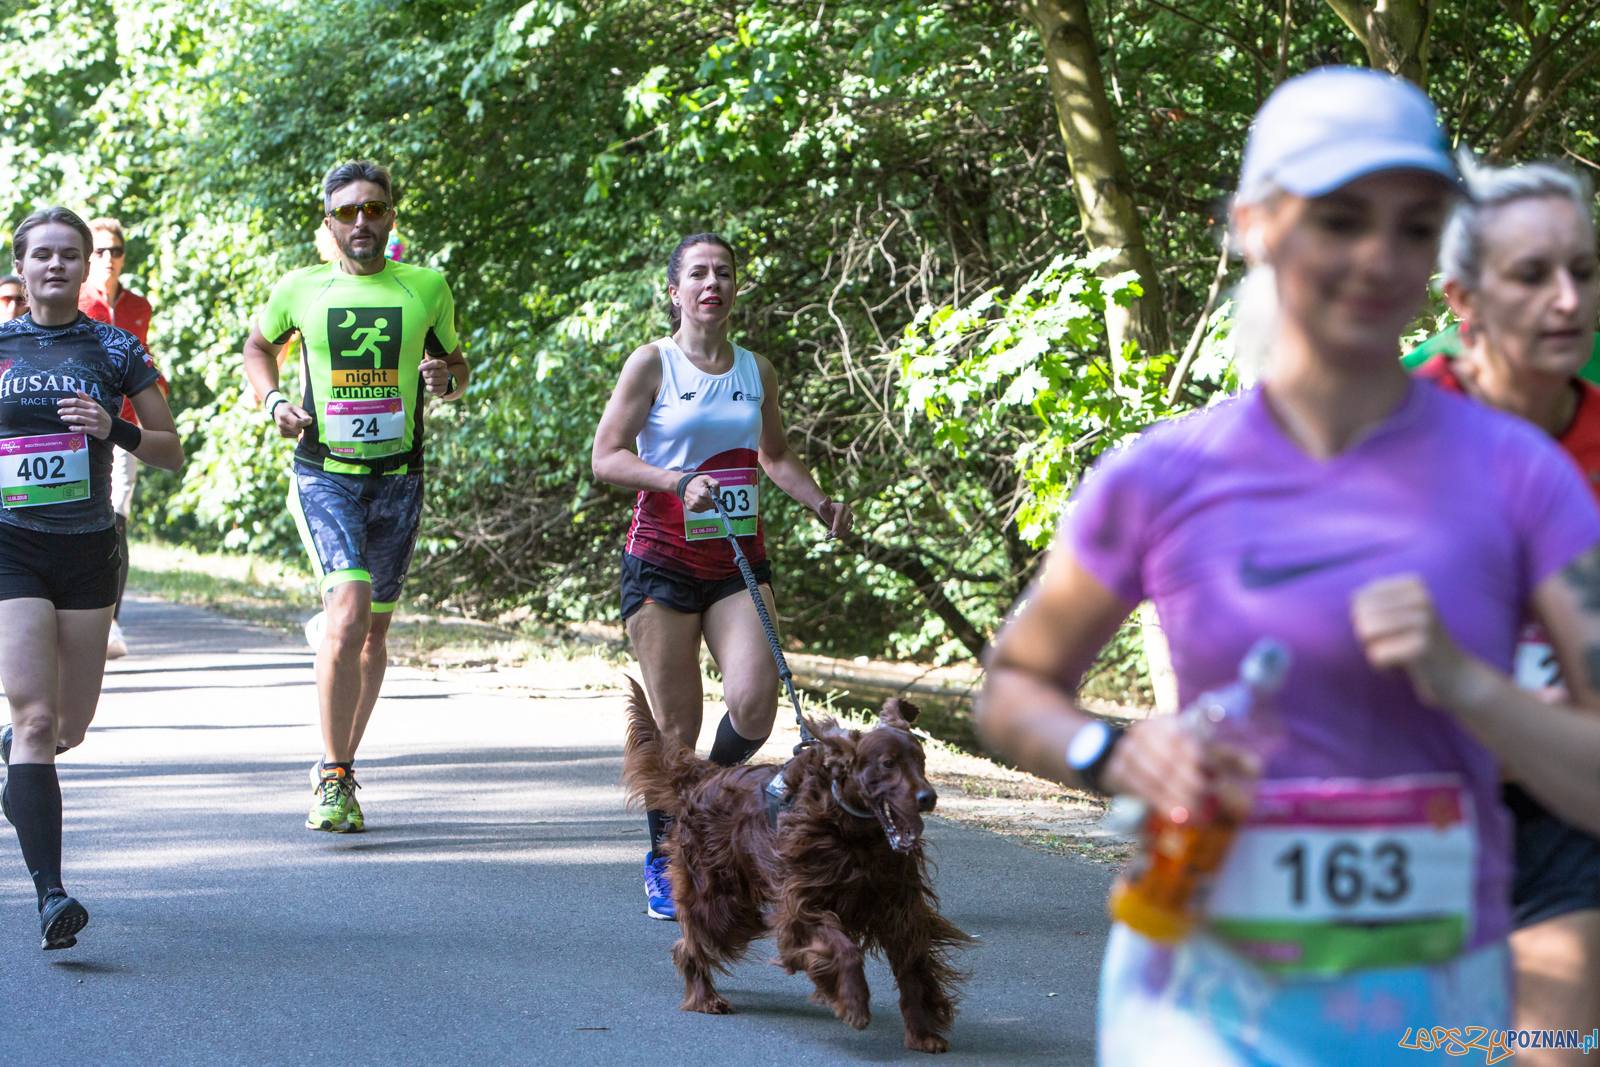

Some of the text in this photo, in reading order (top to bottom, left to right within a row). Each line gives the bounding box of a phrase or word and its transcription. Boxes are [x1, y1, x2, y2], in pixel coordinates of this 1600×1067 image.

[0, 369, 102, 402] HUSARIA
[345, 369, 387, 386] night
[21, 397, 47, 406] RACE
[333, 386, 398, 398] runners
[351, 417, 380, 438] 24
[17, 455, 66, 481] 402
[1274, 838, 1412, 907] 163
